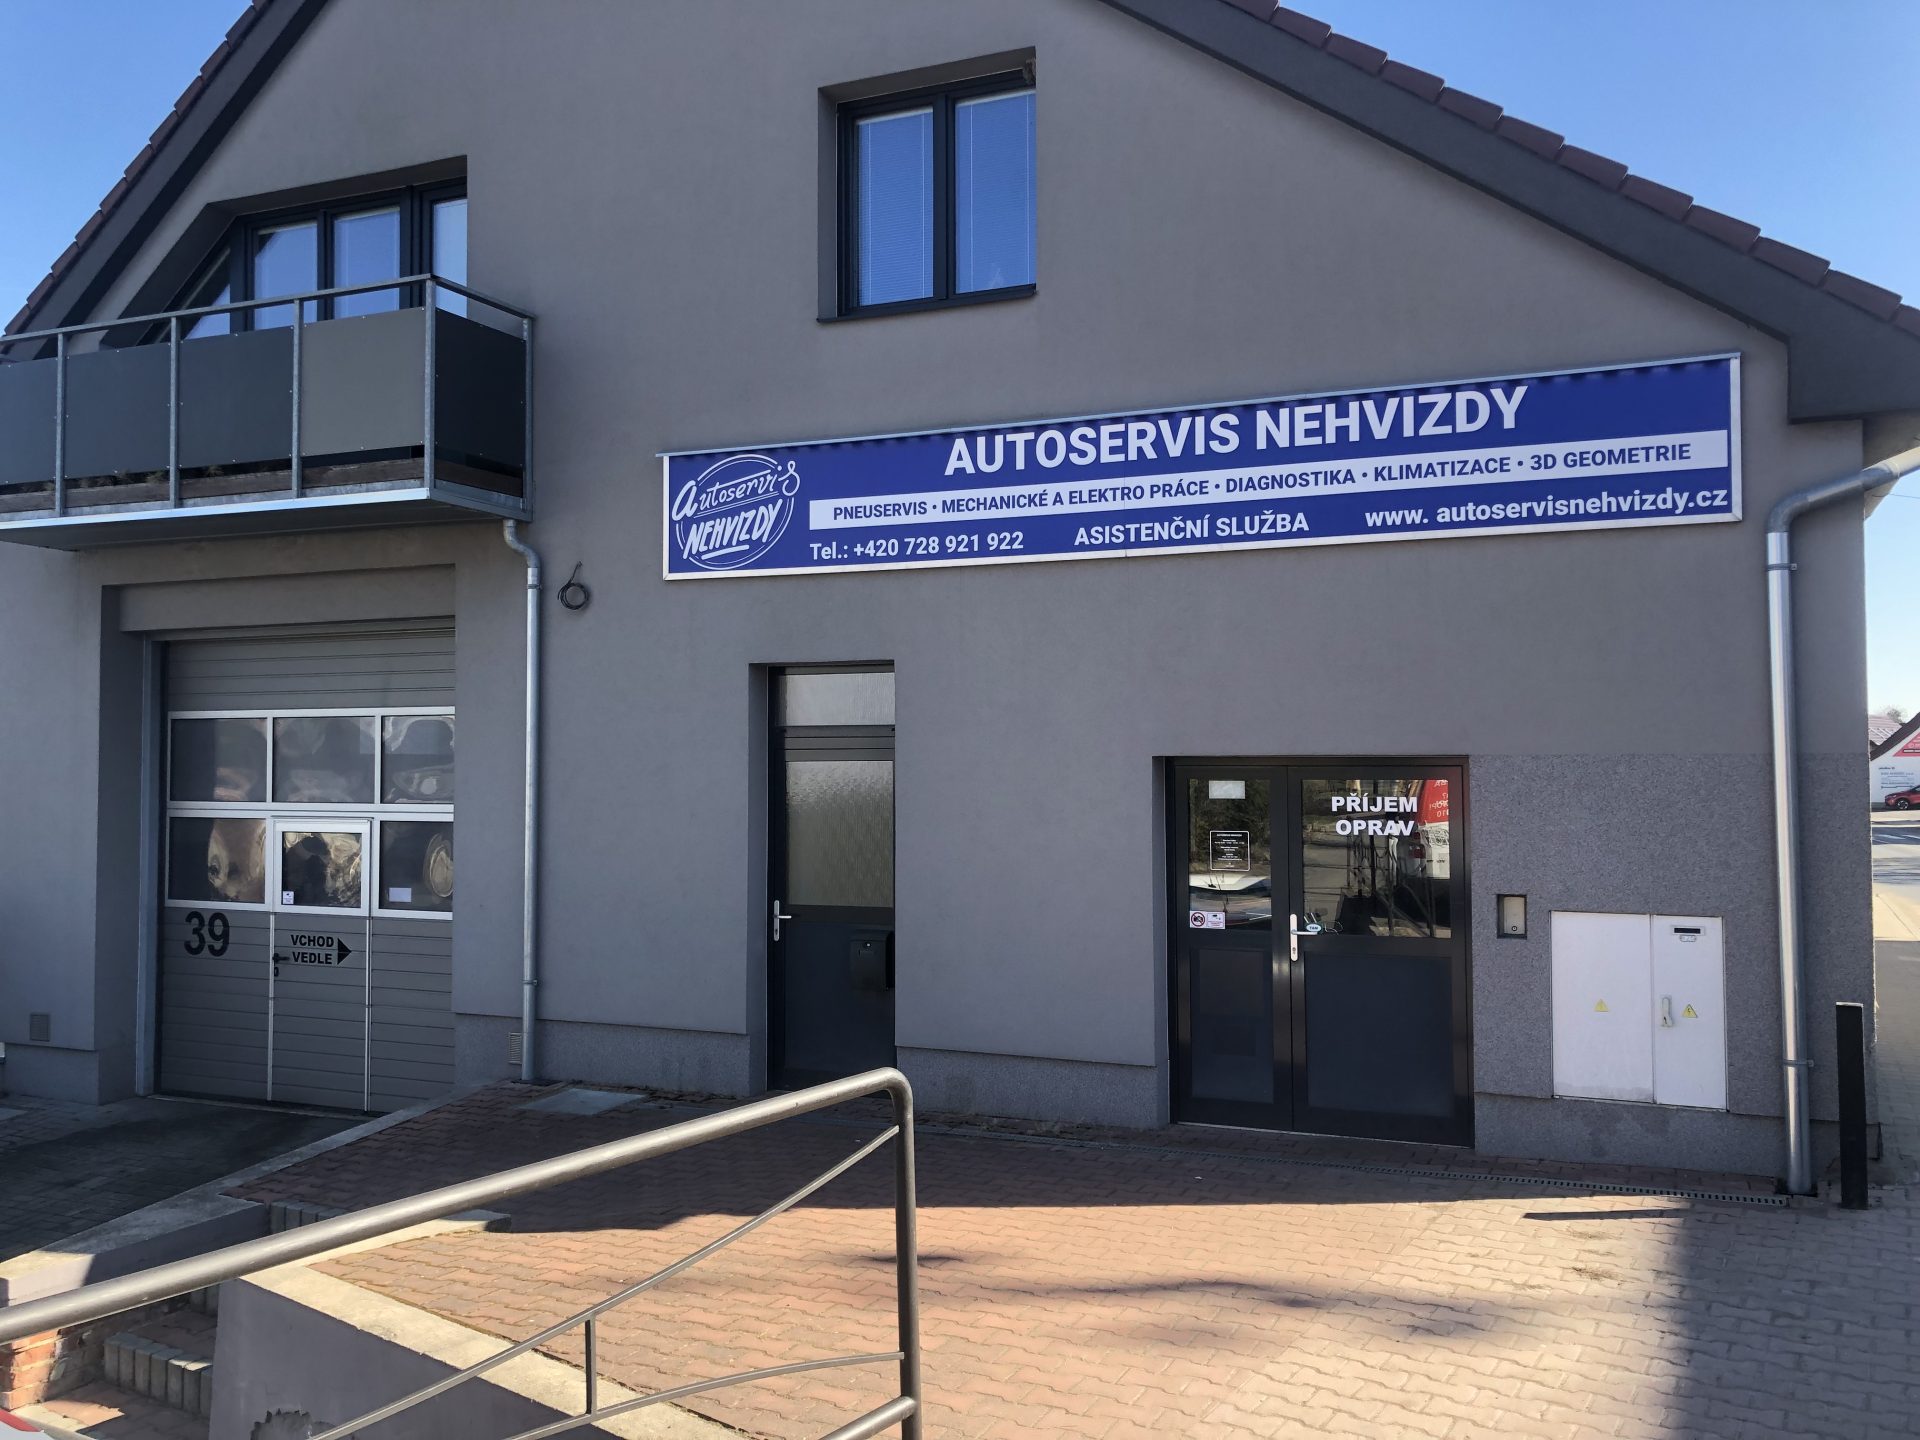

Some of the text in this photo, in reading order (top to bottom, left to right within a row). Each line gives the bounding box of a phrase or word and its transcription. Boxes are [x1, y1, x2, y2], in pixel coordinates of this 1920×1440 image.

[944, 386, 1528, 476] AUTOSERVIS NEHVIZDY
[833, 443, 1691, 521] PNEUSERVIS MECHANICKÉ A ELEKTRO PRÁCE DIAGNOSTIKA KLIMATIZACE 3D GEOMETRIE
[683, 499, 783, 559] NEHVIZDY
[1074, 509, 1309, 546] ASISTENČNÍ SLUŽBA
[809, 530, 1024, 561] Tel.: +420 728 921 922
[1331, 792, 1418, 813] PŘÍJEM
[1335, 819, 1415, 836] OPRAV
[184, 910, 230, 957] 39
[290, 934, 335, 948] VCHOD
[292, 951, 333, 965] VEDLE
